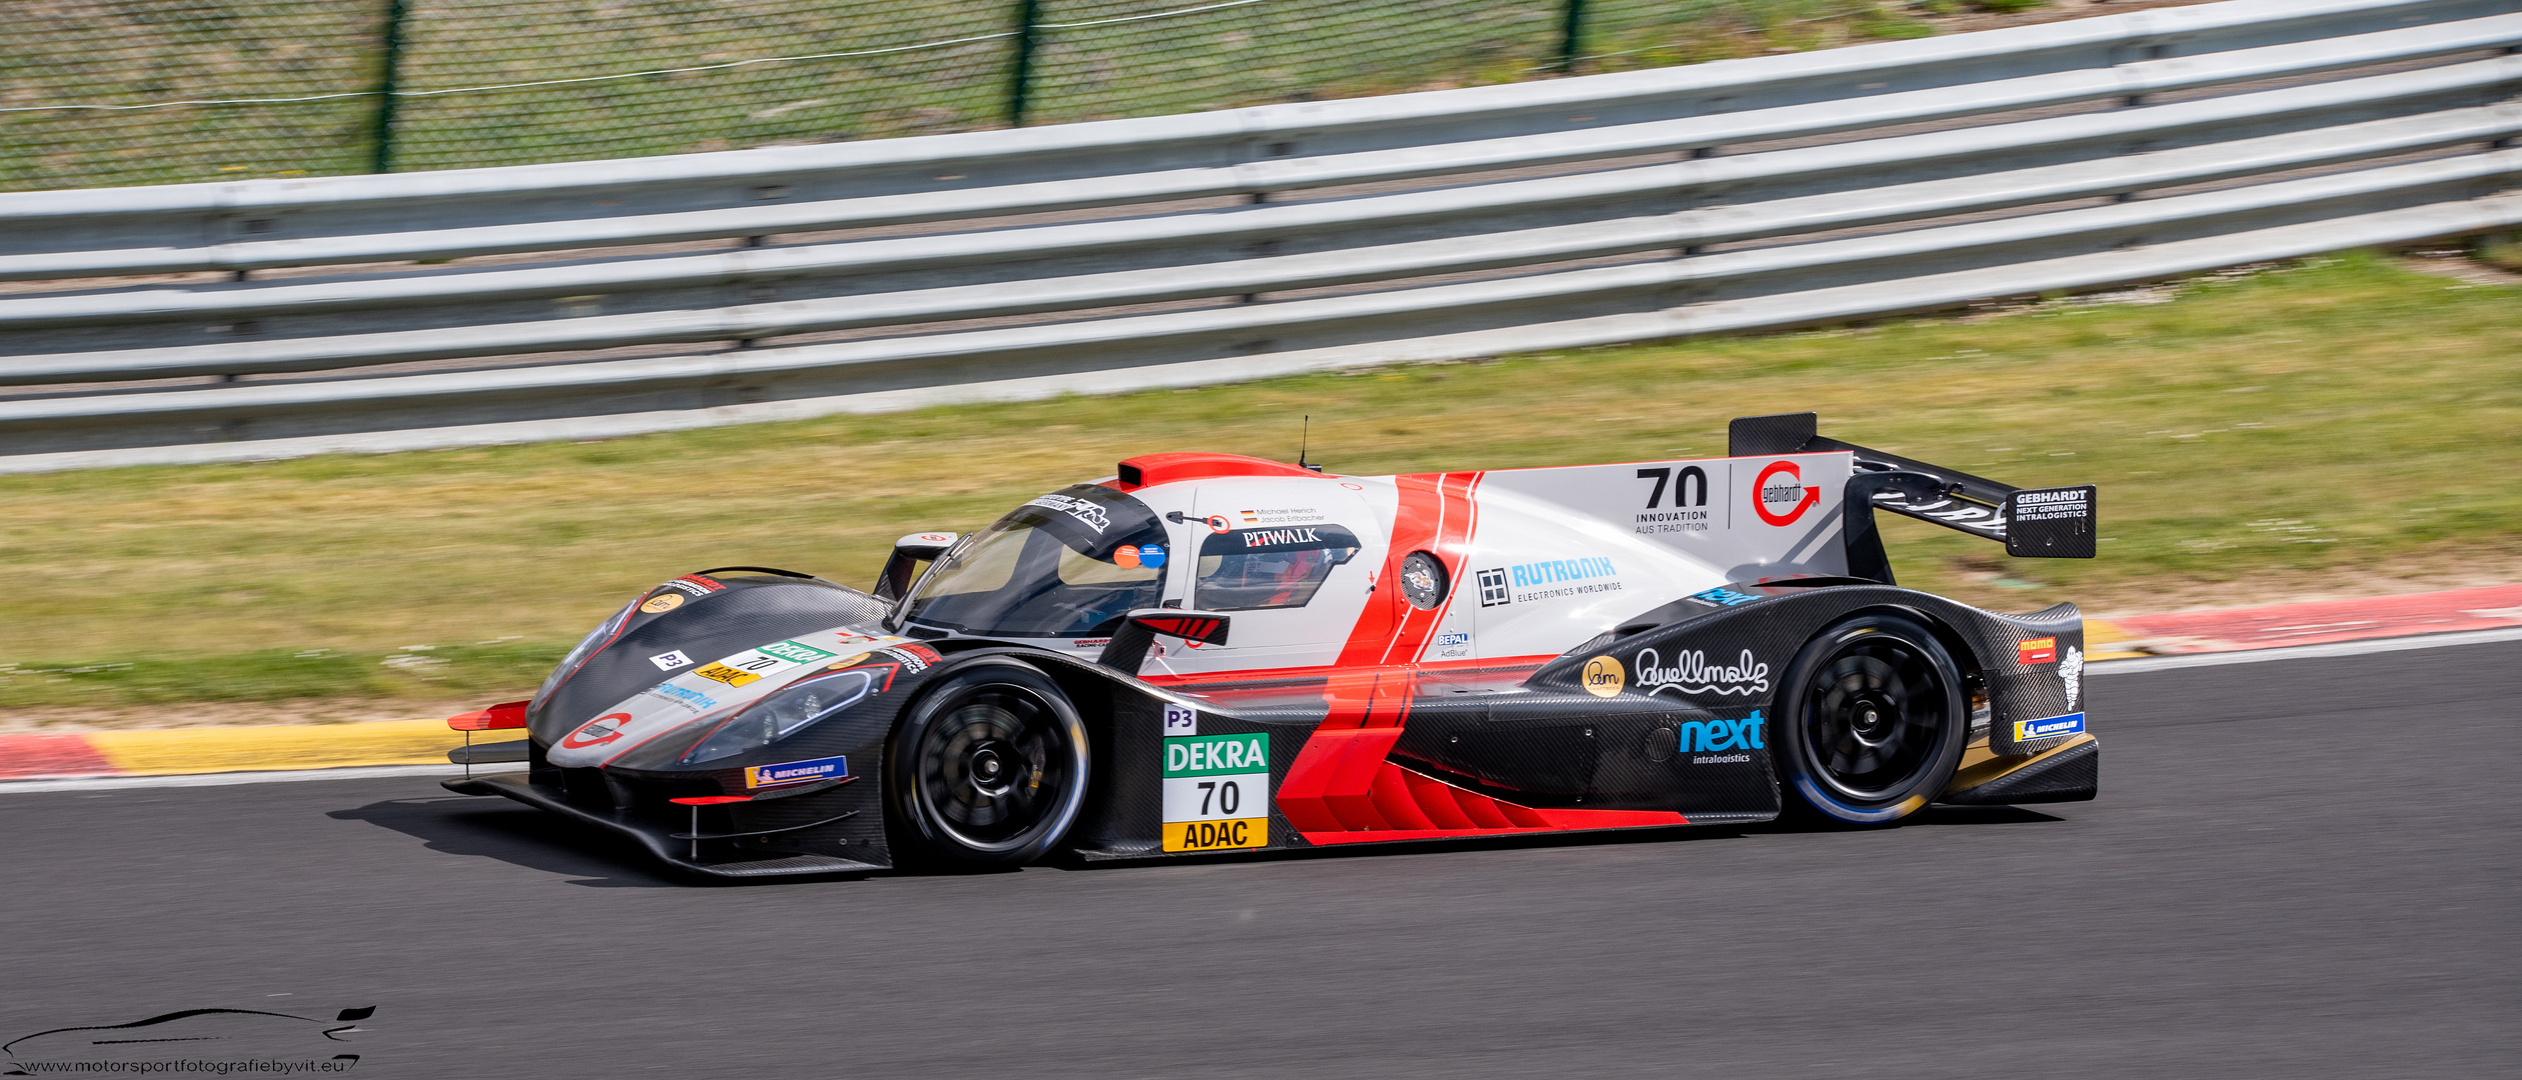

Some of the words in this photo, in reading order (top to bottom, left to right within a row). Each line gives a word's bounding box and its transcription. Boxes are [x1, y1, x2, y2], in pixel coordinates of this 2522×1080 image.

[1763, 483, 1802, 503] gebhardt
[2016, 490, 2087, 504] GEBHARDT
[2016, 506, 2038, 514] NEXT
[2038, 503, 2087, 513] GENERATION
[2016, 510, 2087, 522] INTRALOGISTICS
[1636, 511, 1708, 523] INNOVATION
[1636, 525, 1656, 534] AUS
[1658, 522, 1708, 534] TRADITION
[1243, 528, 1322, 547] PITWALK
[1512, 557, 1617, 587] RUTRONIK
[1518, 588, 1574, 603] ELECTRONICS
[1577, 582, 1622, 594] WORLDWIDE
[1438, 634, 1468, 645] BEPAL
[760, 641, 827, 663] DEKRA
[659, 654, 683, 667] P3
[736, 656, 779, 671] 70
[700, 666, 749, 683] ADAC
[1168, 710, 1193, 728] P3
[2037, 720, 2078, 733] MICHELIN
[1679, 709, 1765, 753] next
[1168, 739, 1266, 772] DEKRA
[1693, 754, 1750, 765] intralogistics
[774, 764, 835, 779] MICHELIN
[1197, 781, 1240, 815] 70
[1184, 821, 1248, 849] ADAC
